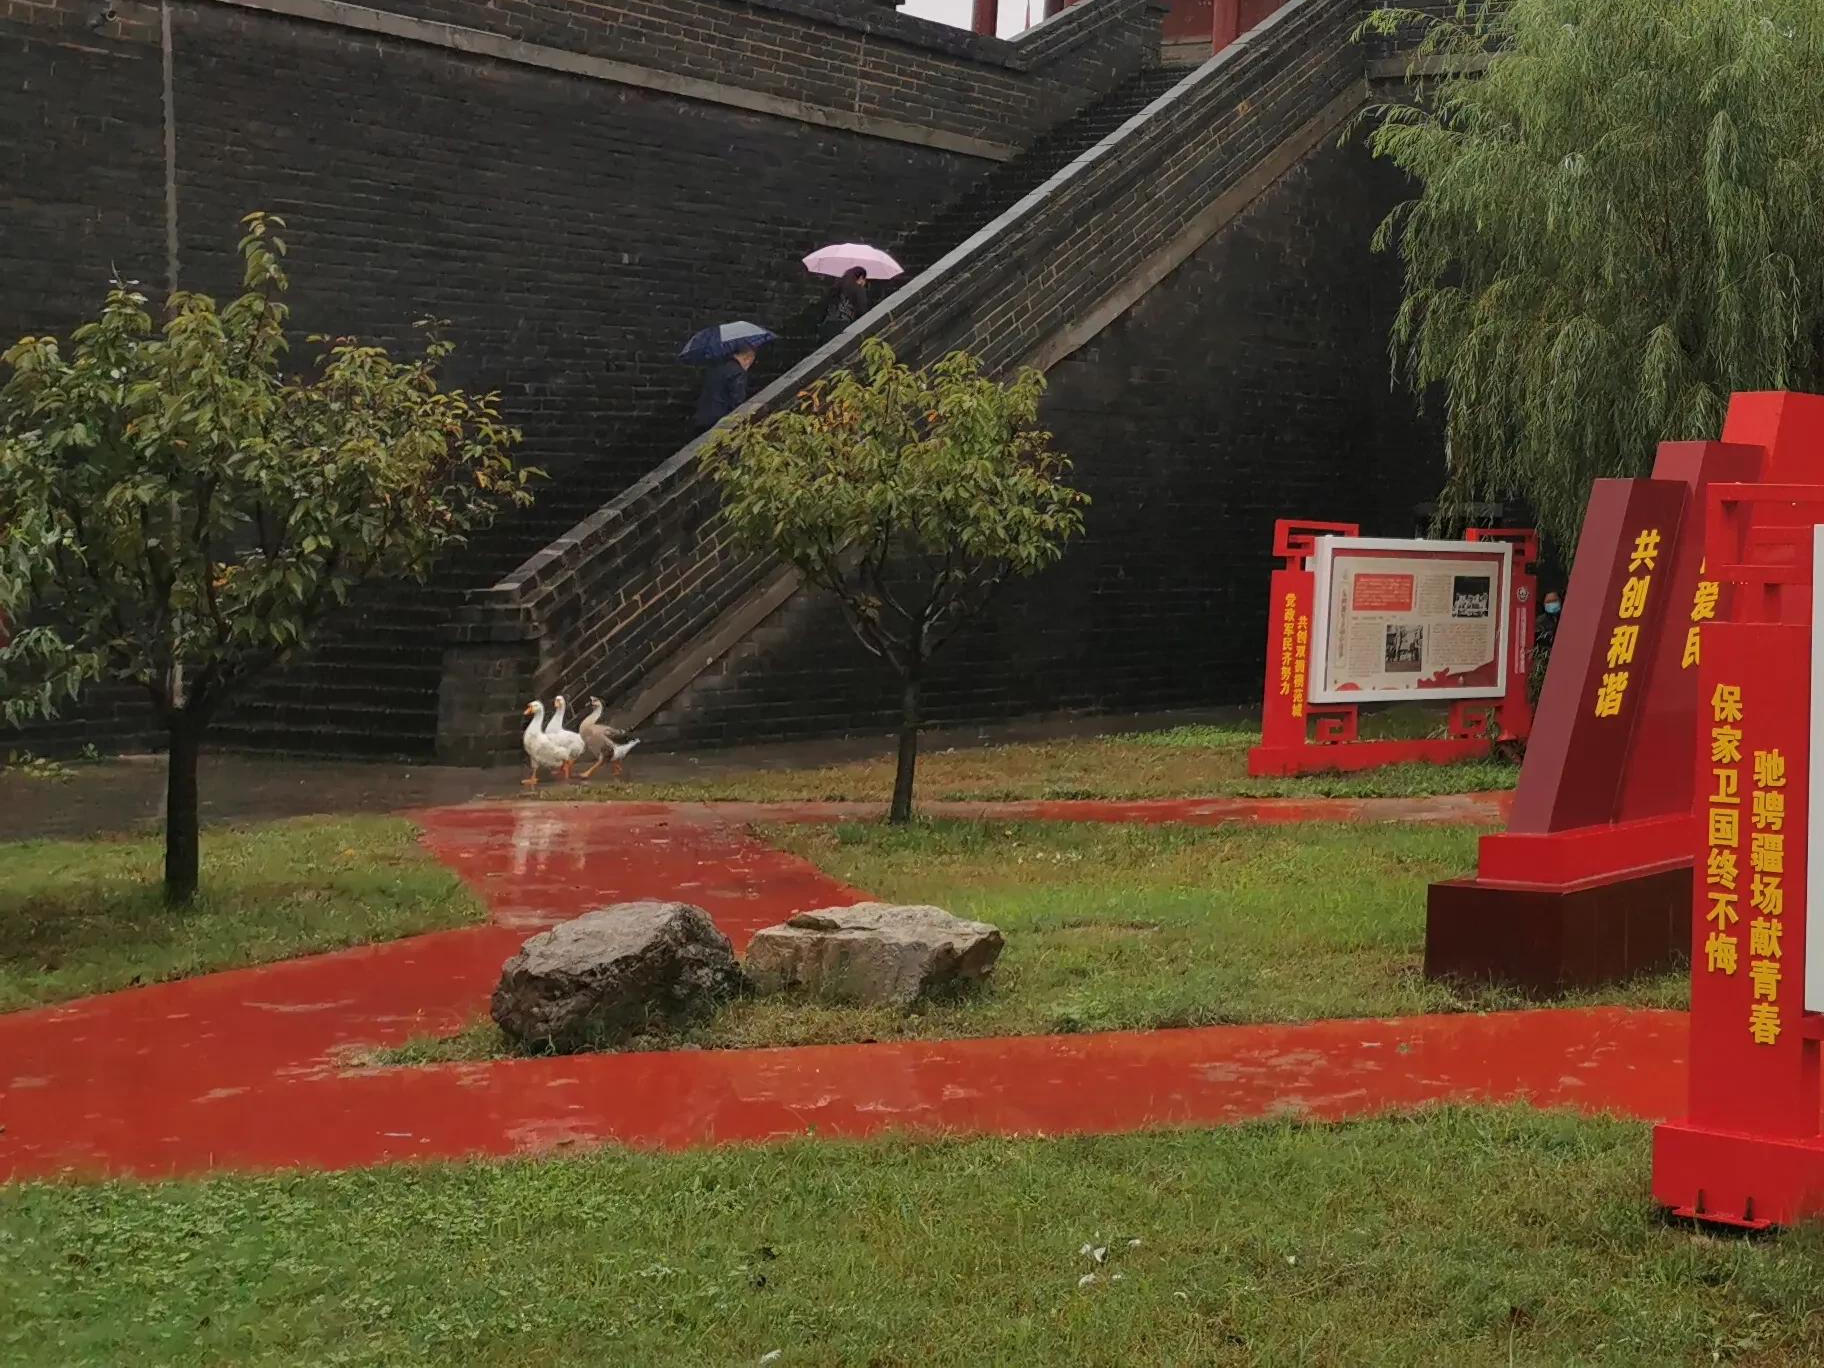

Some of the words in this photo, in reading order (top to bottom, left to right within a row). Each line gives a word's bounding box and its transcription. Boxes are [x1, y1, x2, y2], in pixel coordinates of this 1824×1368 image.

[1595, 528, 1661, 718] 共创和谐
[1705, 683, 1743, 975] 保家卫国终不悔
[1749, 749, 1787, 1045] 驰骋疆场献青春
